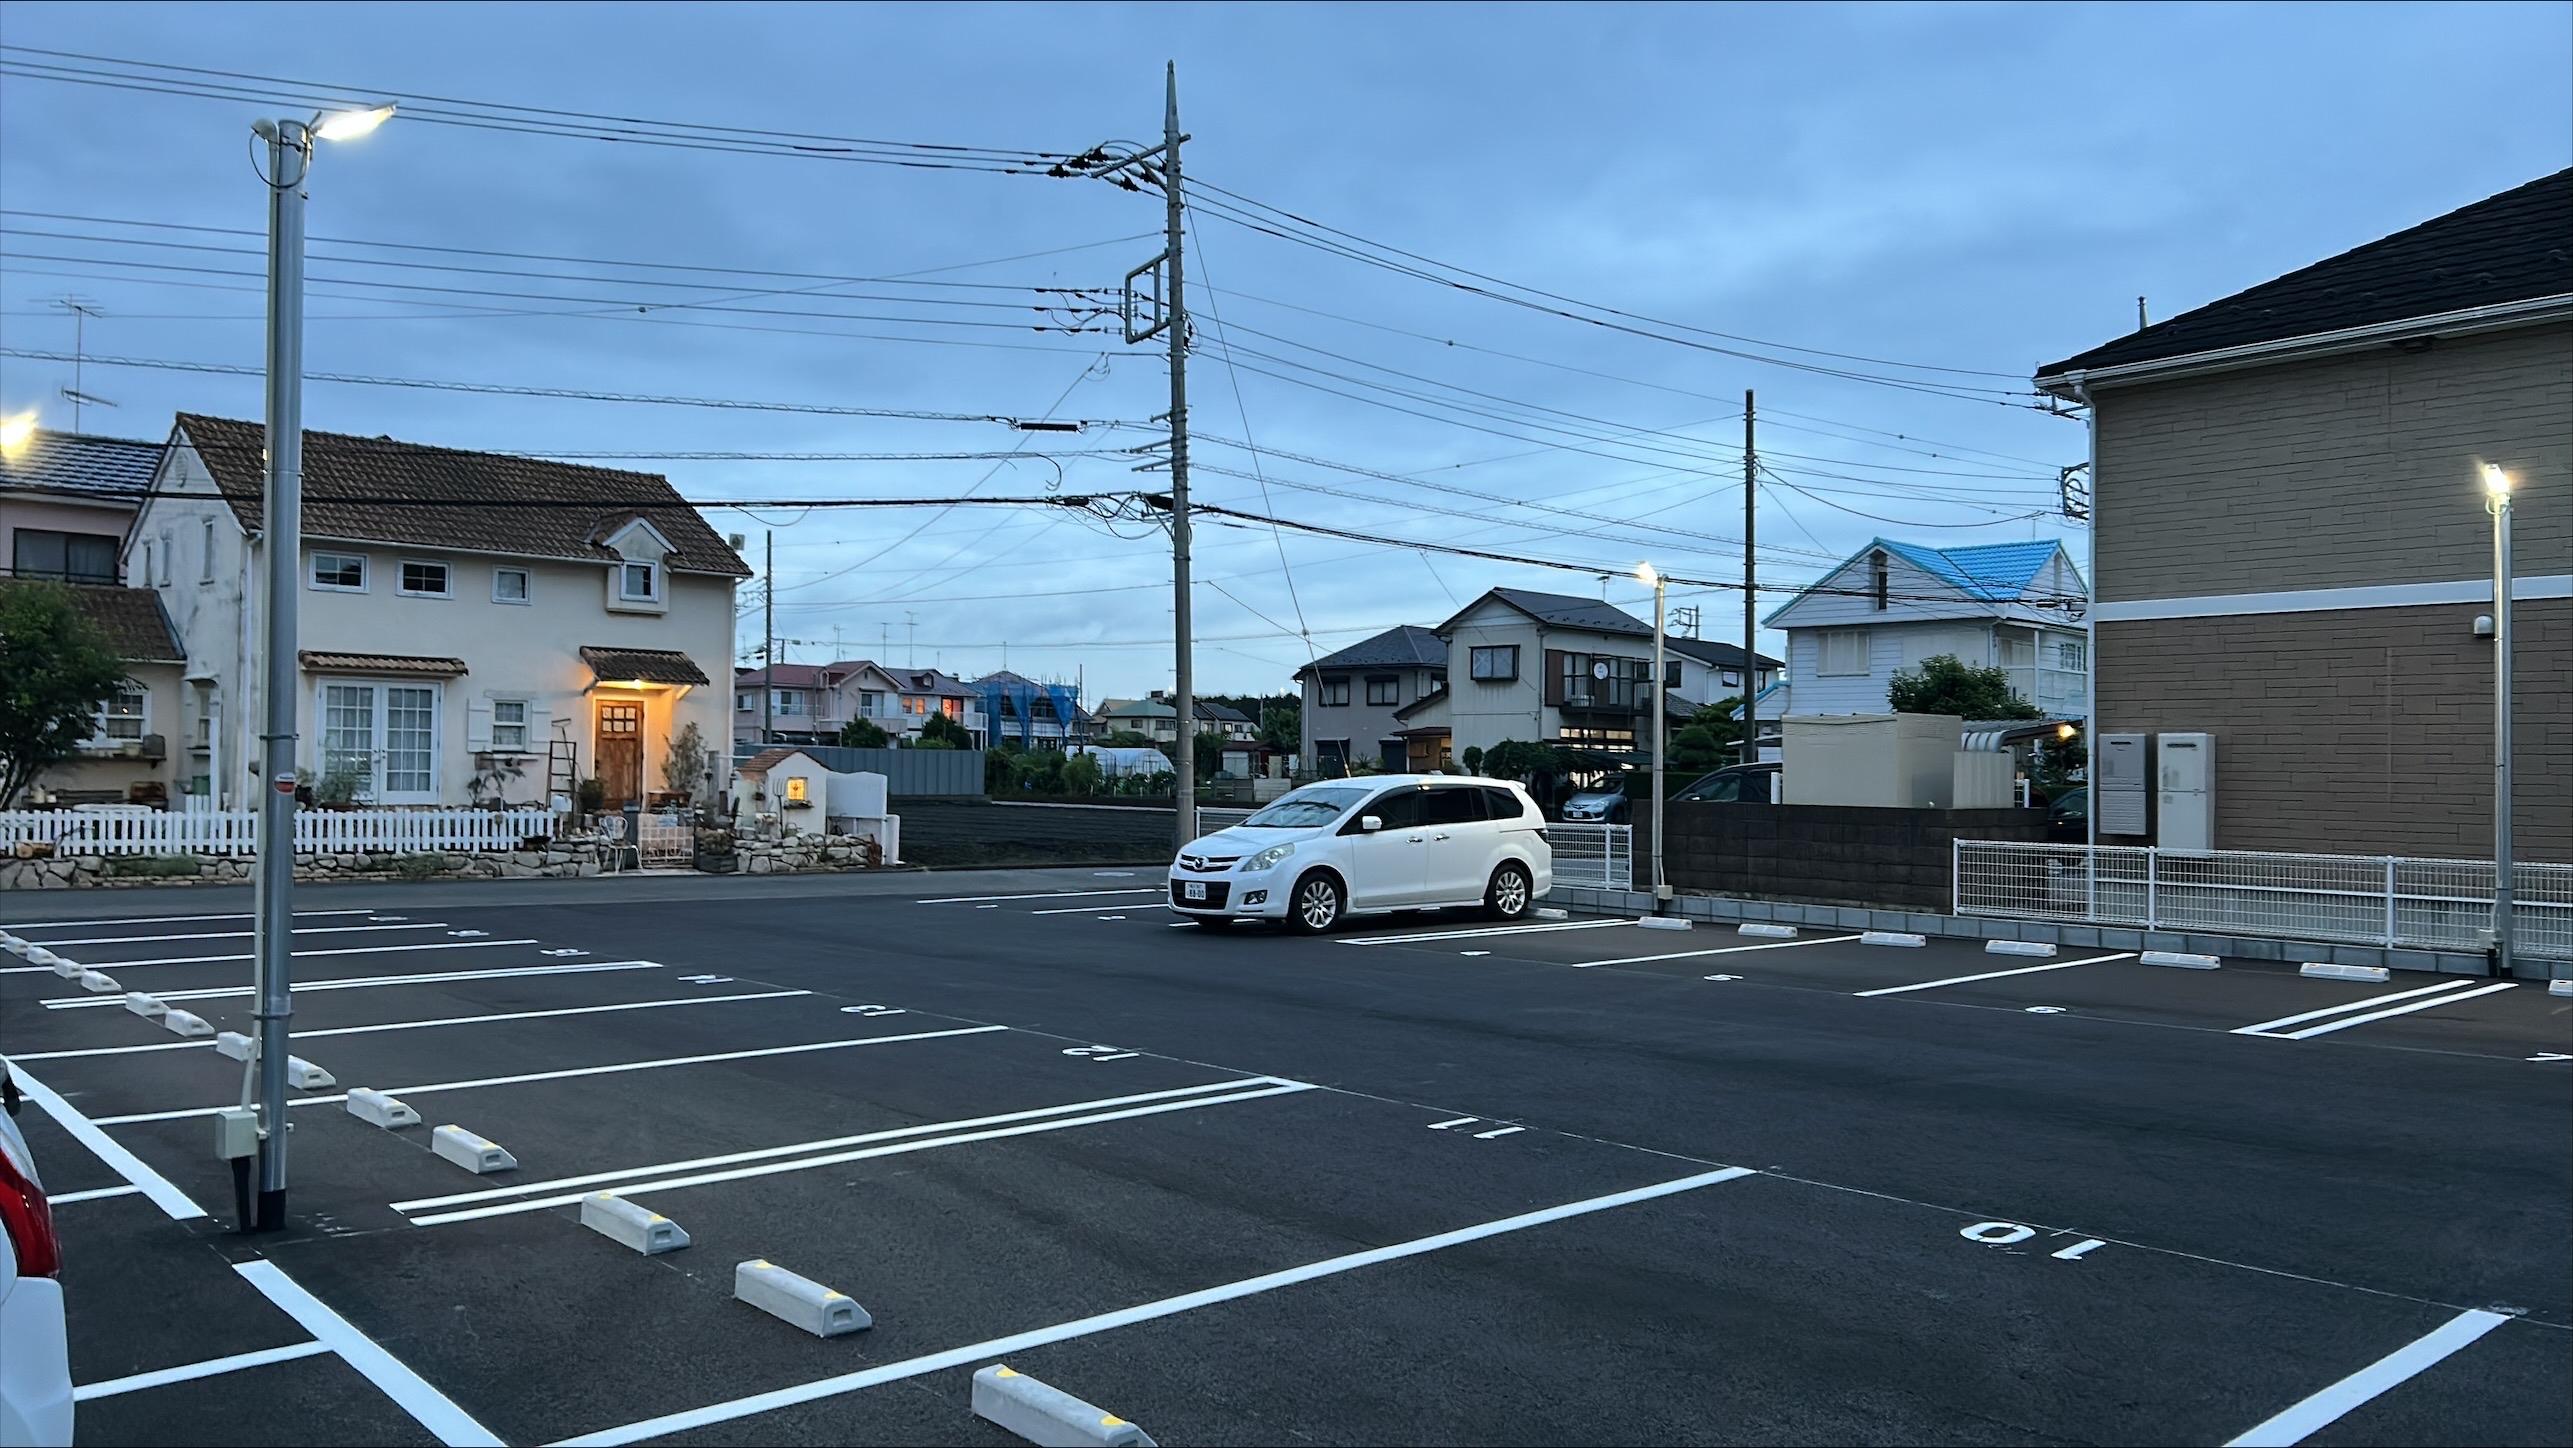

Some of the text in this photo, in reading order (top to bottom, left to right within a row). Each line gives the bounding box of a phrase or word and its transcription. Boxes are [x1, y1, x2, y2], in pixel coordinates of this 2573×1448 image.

[840, 1004, 906, 1017] 13
[2024, 1005, 2067, 1014] 6
[1062, 1044, 1140, 1062] 12
[1427, 1116, 1526, 1139] 11
[1959, 1221, 2107, 1260] 10
